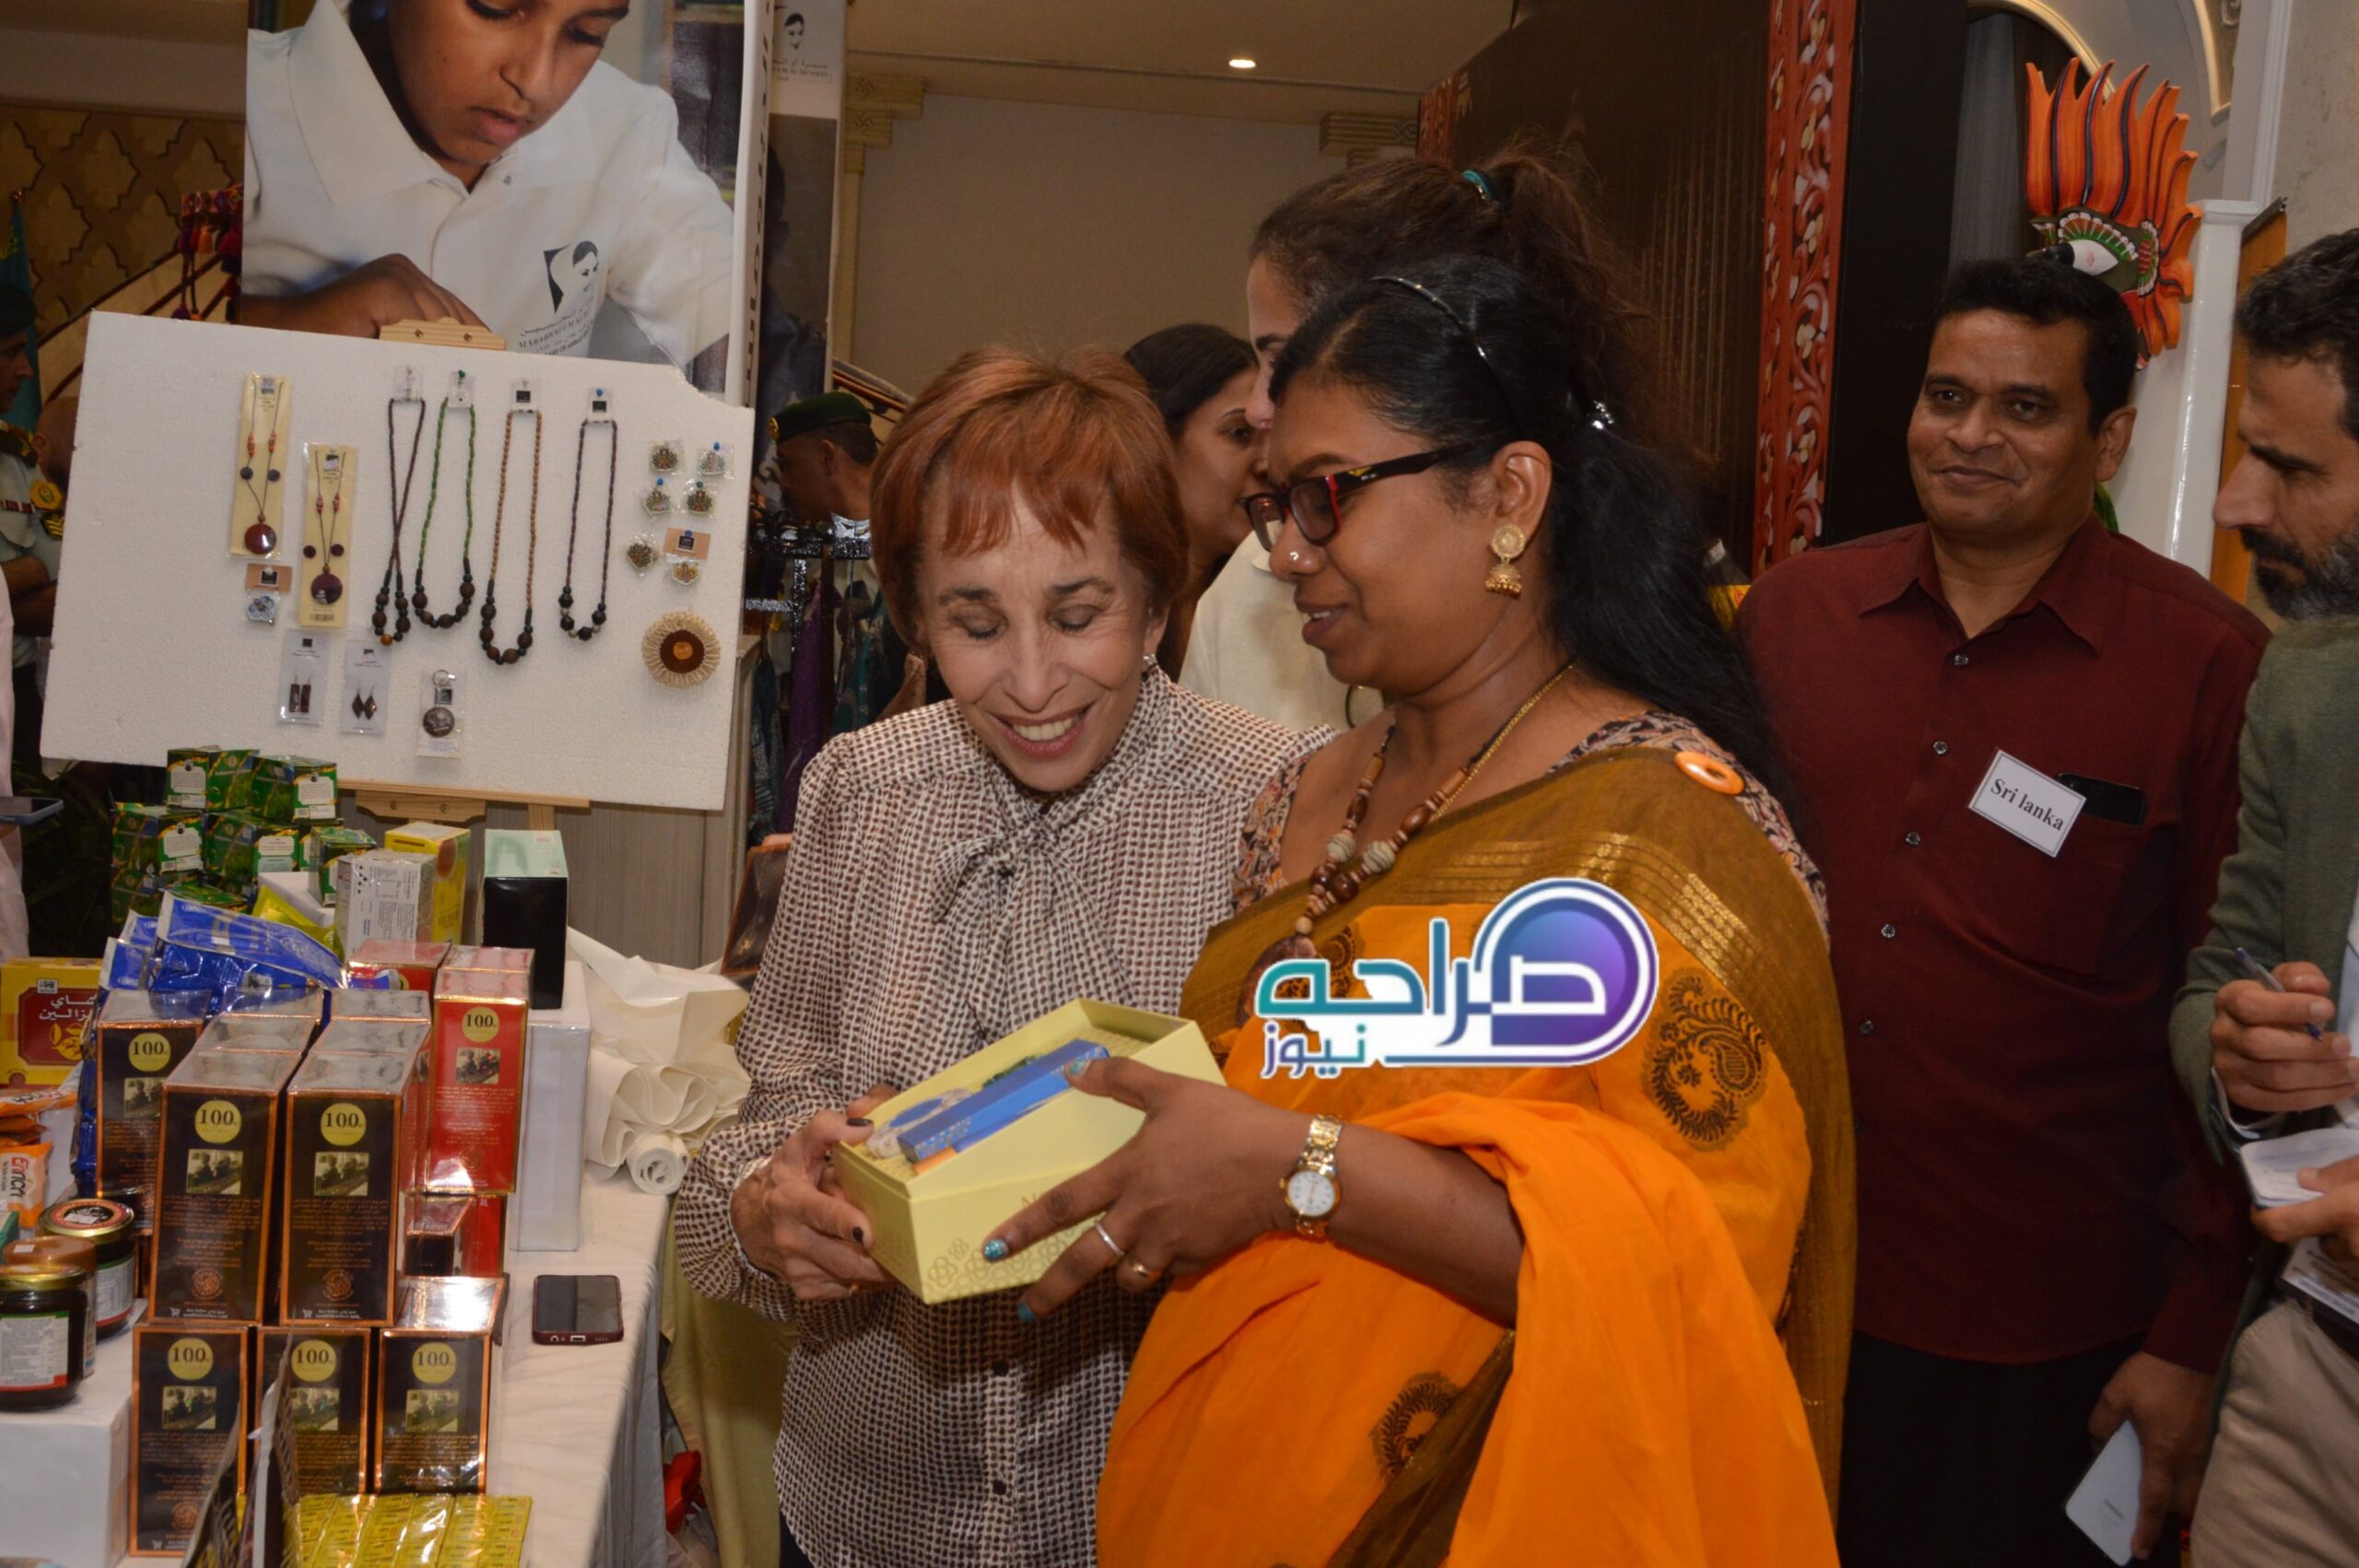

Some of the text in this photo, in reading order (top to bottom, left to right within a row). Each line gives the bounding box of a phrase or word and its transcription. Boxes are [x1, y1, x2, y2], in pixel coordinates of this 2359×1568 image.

[1990, 778, 2064, 831] Sri lanka
[39, 1008, 92, 1022] زالين
